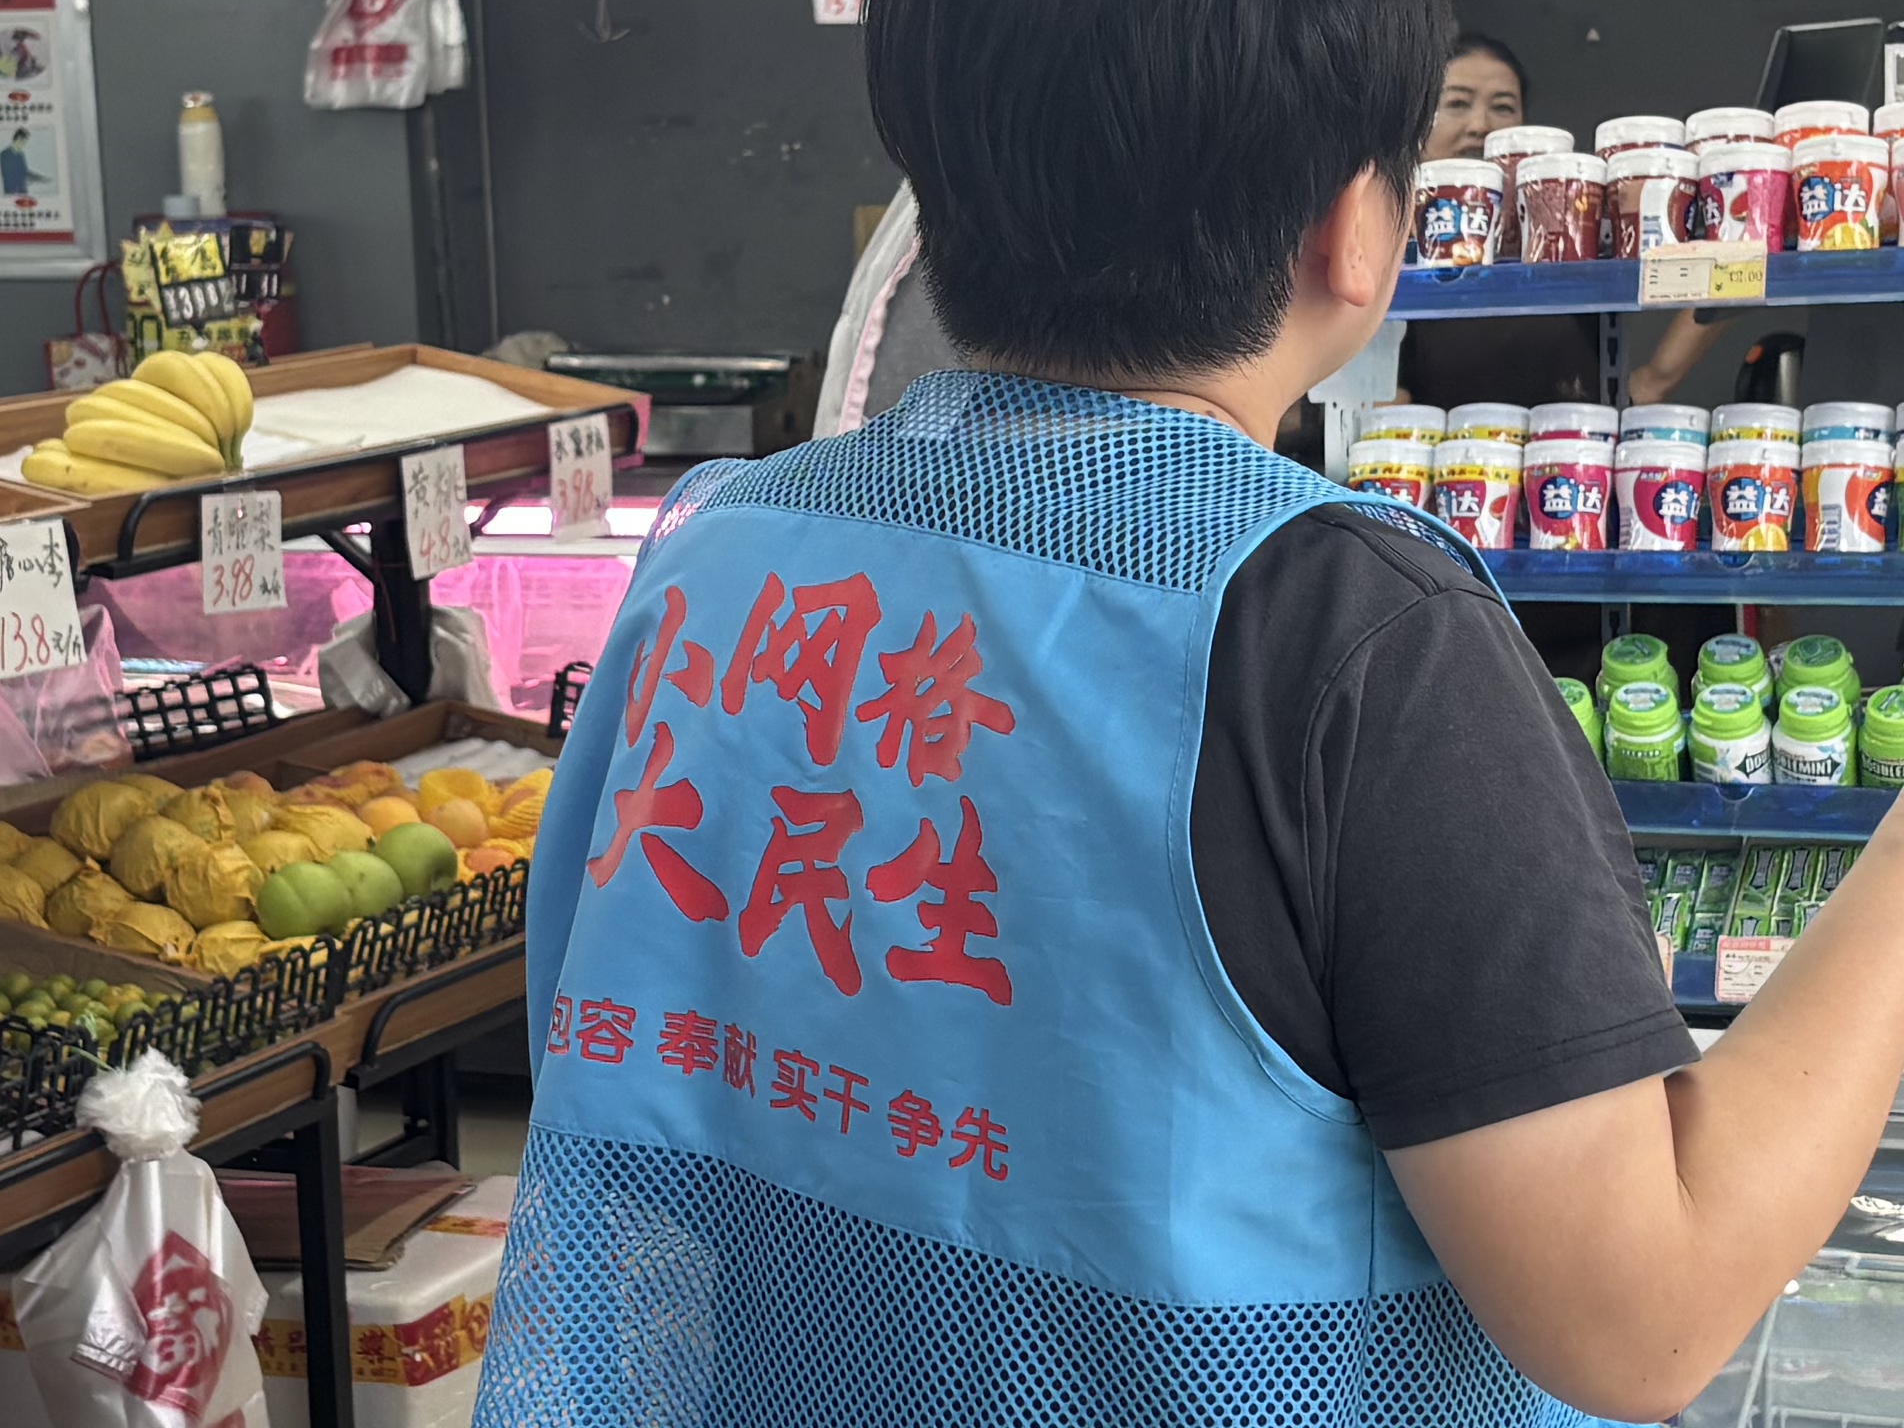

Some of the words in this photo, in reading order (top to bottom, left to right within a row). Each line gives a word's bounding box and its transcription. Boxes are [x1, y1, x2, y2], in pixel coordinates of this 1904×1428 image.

[1425, 203, 1489, 237] 益达
[1802, 179, 1866, 214] 益达
[1544, 484, 1601, 514] 益达
[1726, 482, 1791, 514] 益达
[213, 555, 254, 606] 3.98
[0, 612, 50, 672] 13.8
[626, 572, 1016, 786] 小网格
[587, 722, 1014, 1007] 大民生
[657, 1010, 756, 1099] 奉献
[769, 1048, 870, 1135] 实干
[887, 1090, 1010, 1181] 争先
